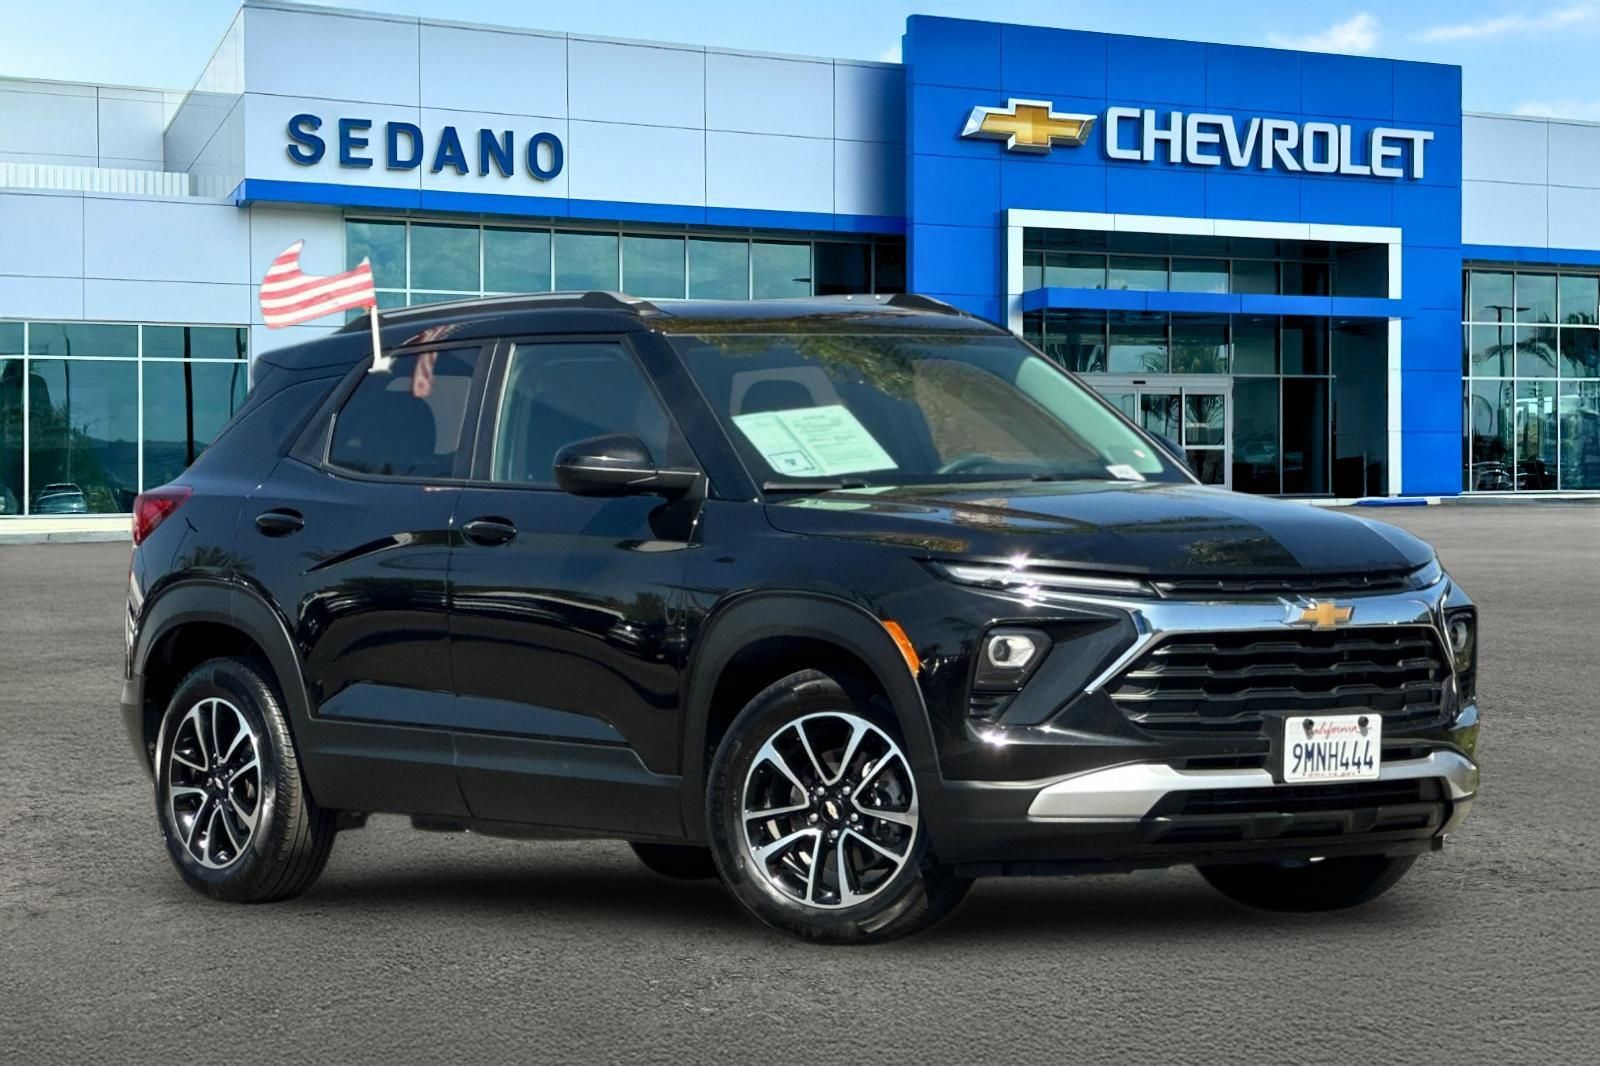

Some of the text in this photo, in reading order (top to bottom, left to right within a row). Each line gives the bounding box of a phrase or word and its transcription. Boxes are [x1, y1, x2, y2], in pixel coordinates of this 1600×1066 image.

[287, 113, 564, 181] SEDANO
[1105, 106, 1435, 178] CHEVROLET
[1291, 740, 1374, 774] 9MNH444
